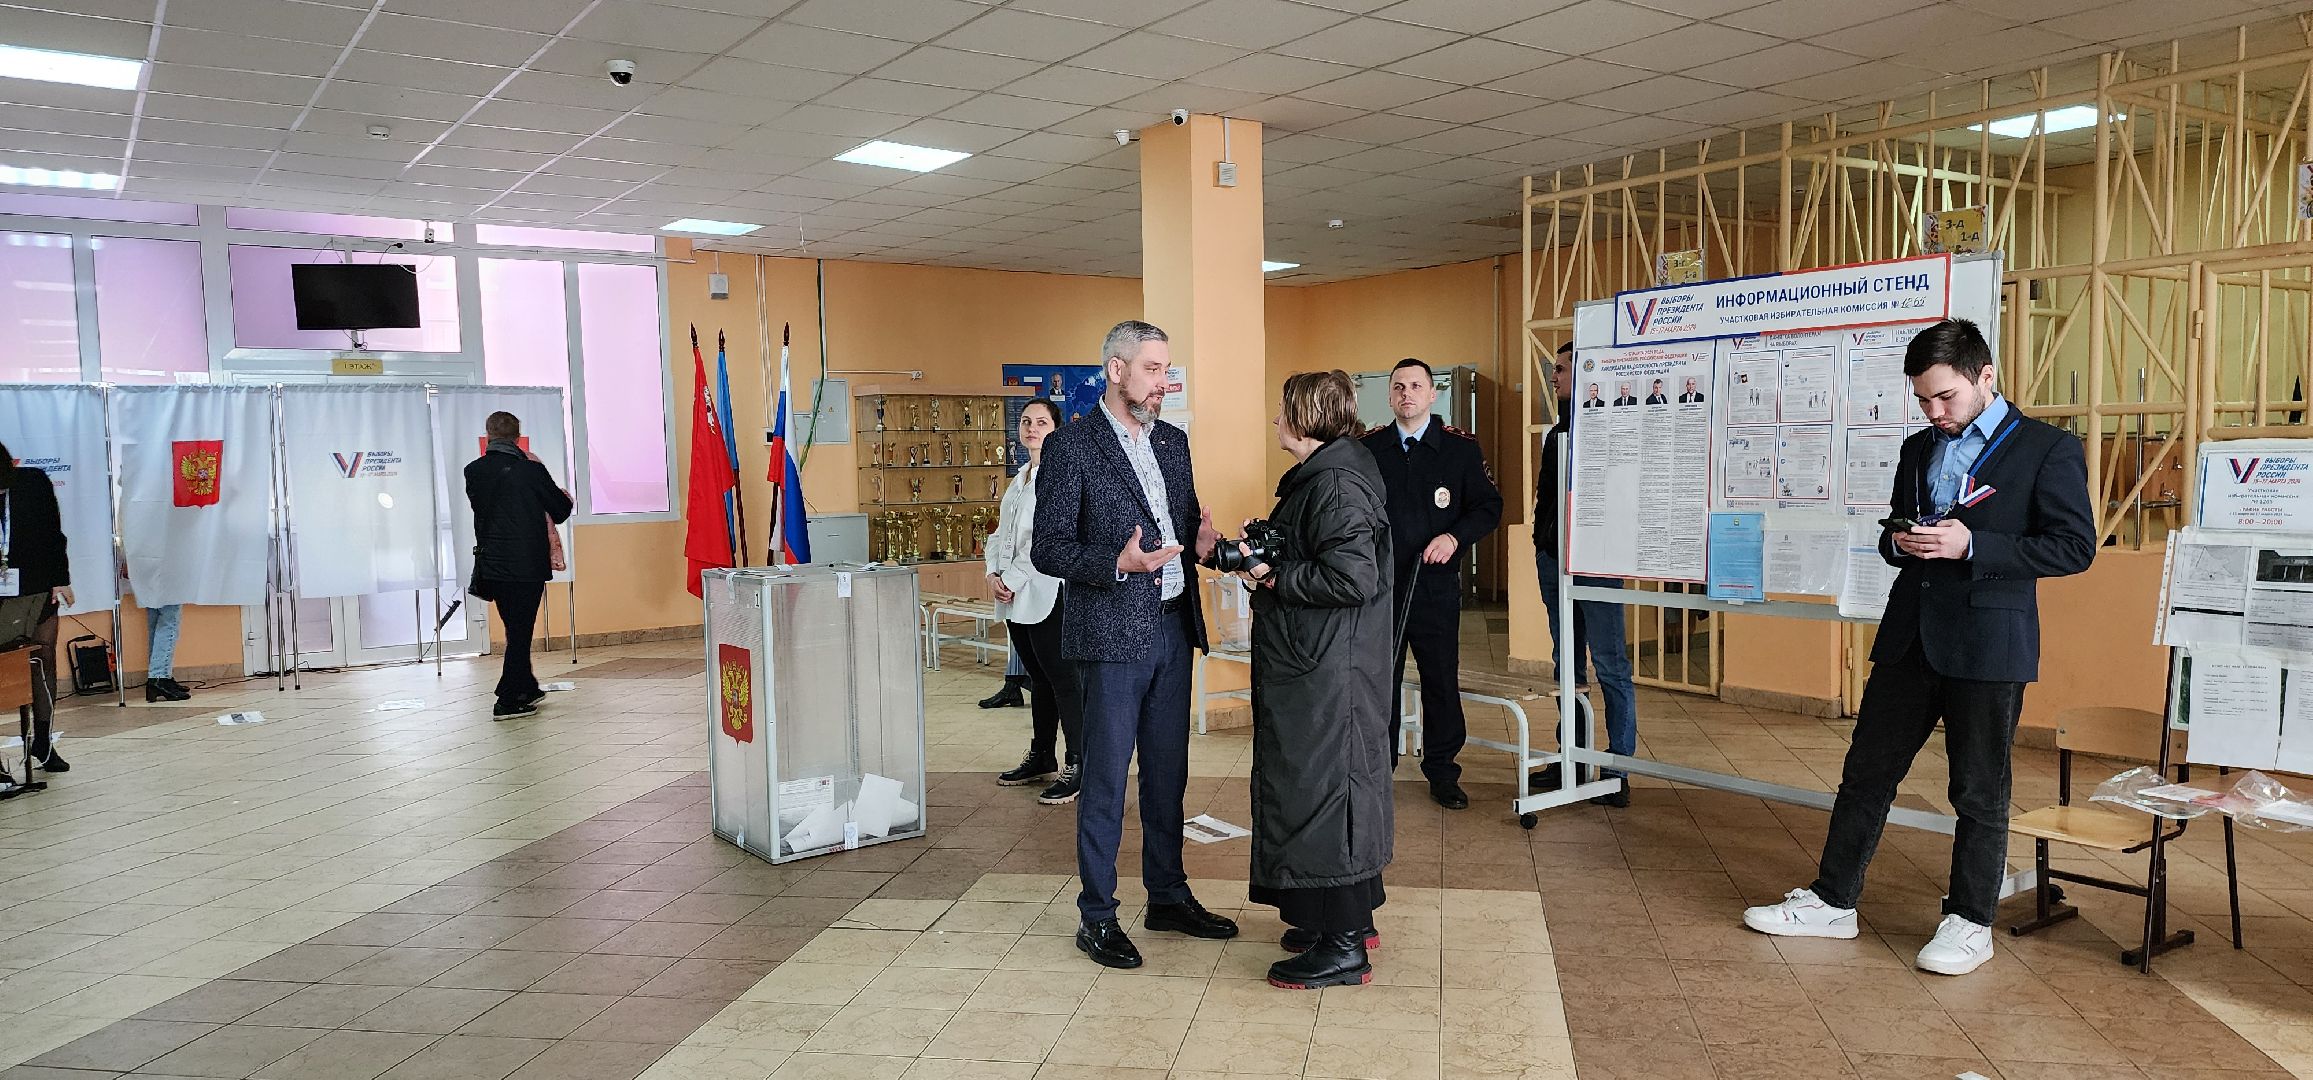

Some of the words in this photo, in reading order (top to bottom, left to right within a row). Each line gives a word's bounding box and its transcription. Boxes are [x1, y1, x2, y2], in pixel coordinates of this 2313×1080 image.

[1716, 276, 1868, 308] ИНФОРМАЦИОННЫЙ
[1873, 273, 1929, 292] СТЕНД
[1660, 294, 1695, 305] ВЫБОРЫ
[1656, 303, 1705, 315] ПРЕЗИДЕНТА
[1720, 312, 1769, 324] УЧАСТКОВАЯ
[1770, 306, 1838, 319] ИЗБИРАТЕЛЬНАЯ
[1840, 301, 1888, 313] КОМИССИЯ
[1891, 300, 1900, 309] №
[1652, 315, 1683, 326] РОССИИ
